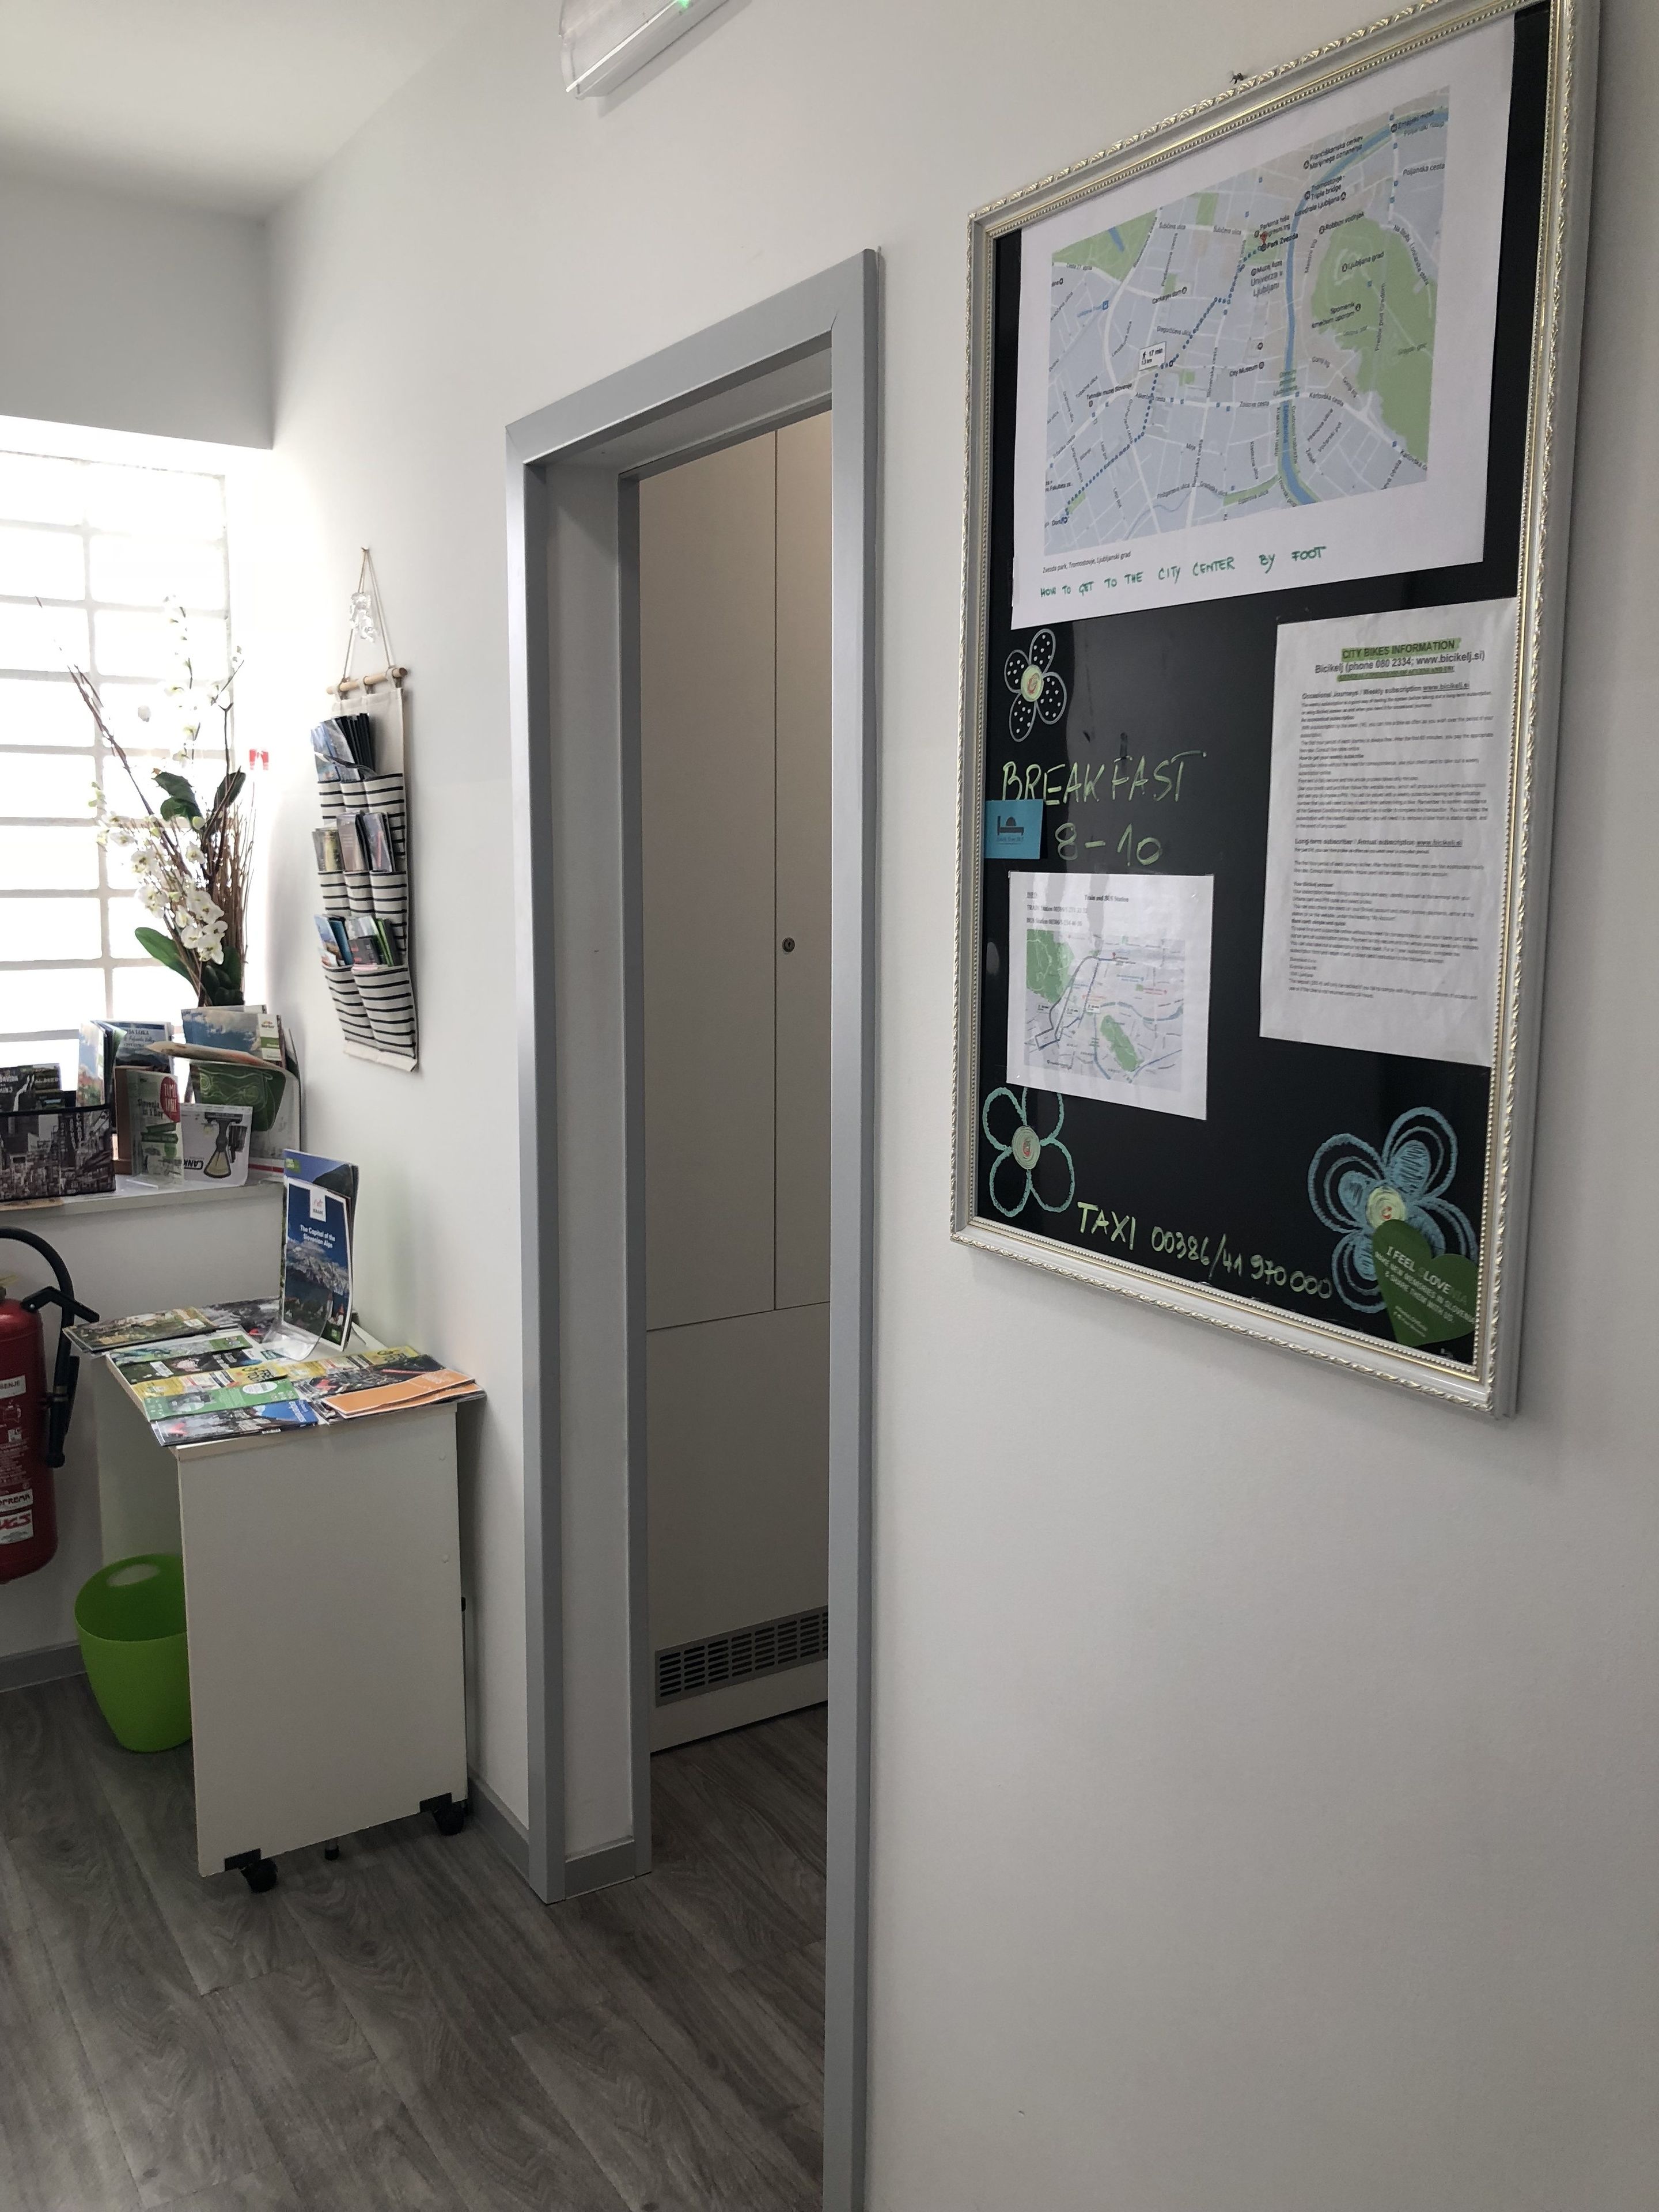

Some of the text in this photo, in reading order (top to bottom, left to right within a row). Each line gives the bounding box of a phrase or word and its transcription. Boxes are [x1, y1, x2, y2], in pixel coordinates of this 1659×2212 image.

[1267, 233, 1298, 249] Park Zvezda
[1229, 363, 1258, 377] City Museum
[1120, 551, 1131, 560] grad
[1040, 546, 1327, 598] HOW TO GET TO THE CITY CENTER BY FOOT
[1342, 639, 1456, 660] CITY BIKES INFORMATION
[1314, 662, 1344, 674] Bicikelj
[1344, 660, 1374, 674] (phone
[1002, 750, 1207, 805] BREAKFAST
[300, 1224, 308, 1232] The
[309, 1227, 324, 1238] Capital
[324, 1240, 334, 1249] Alps
[1077, 1201, 1136, 1250] TAXI
[1151, 1225, 1243, 1280] 00386/41
[1386, 1246, 1394, 1256] I
[1392, 1249, 1416, 1273] FEEL
